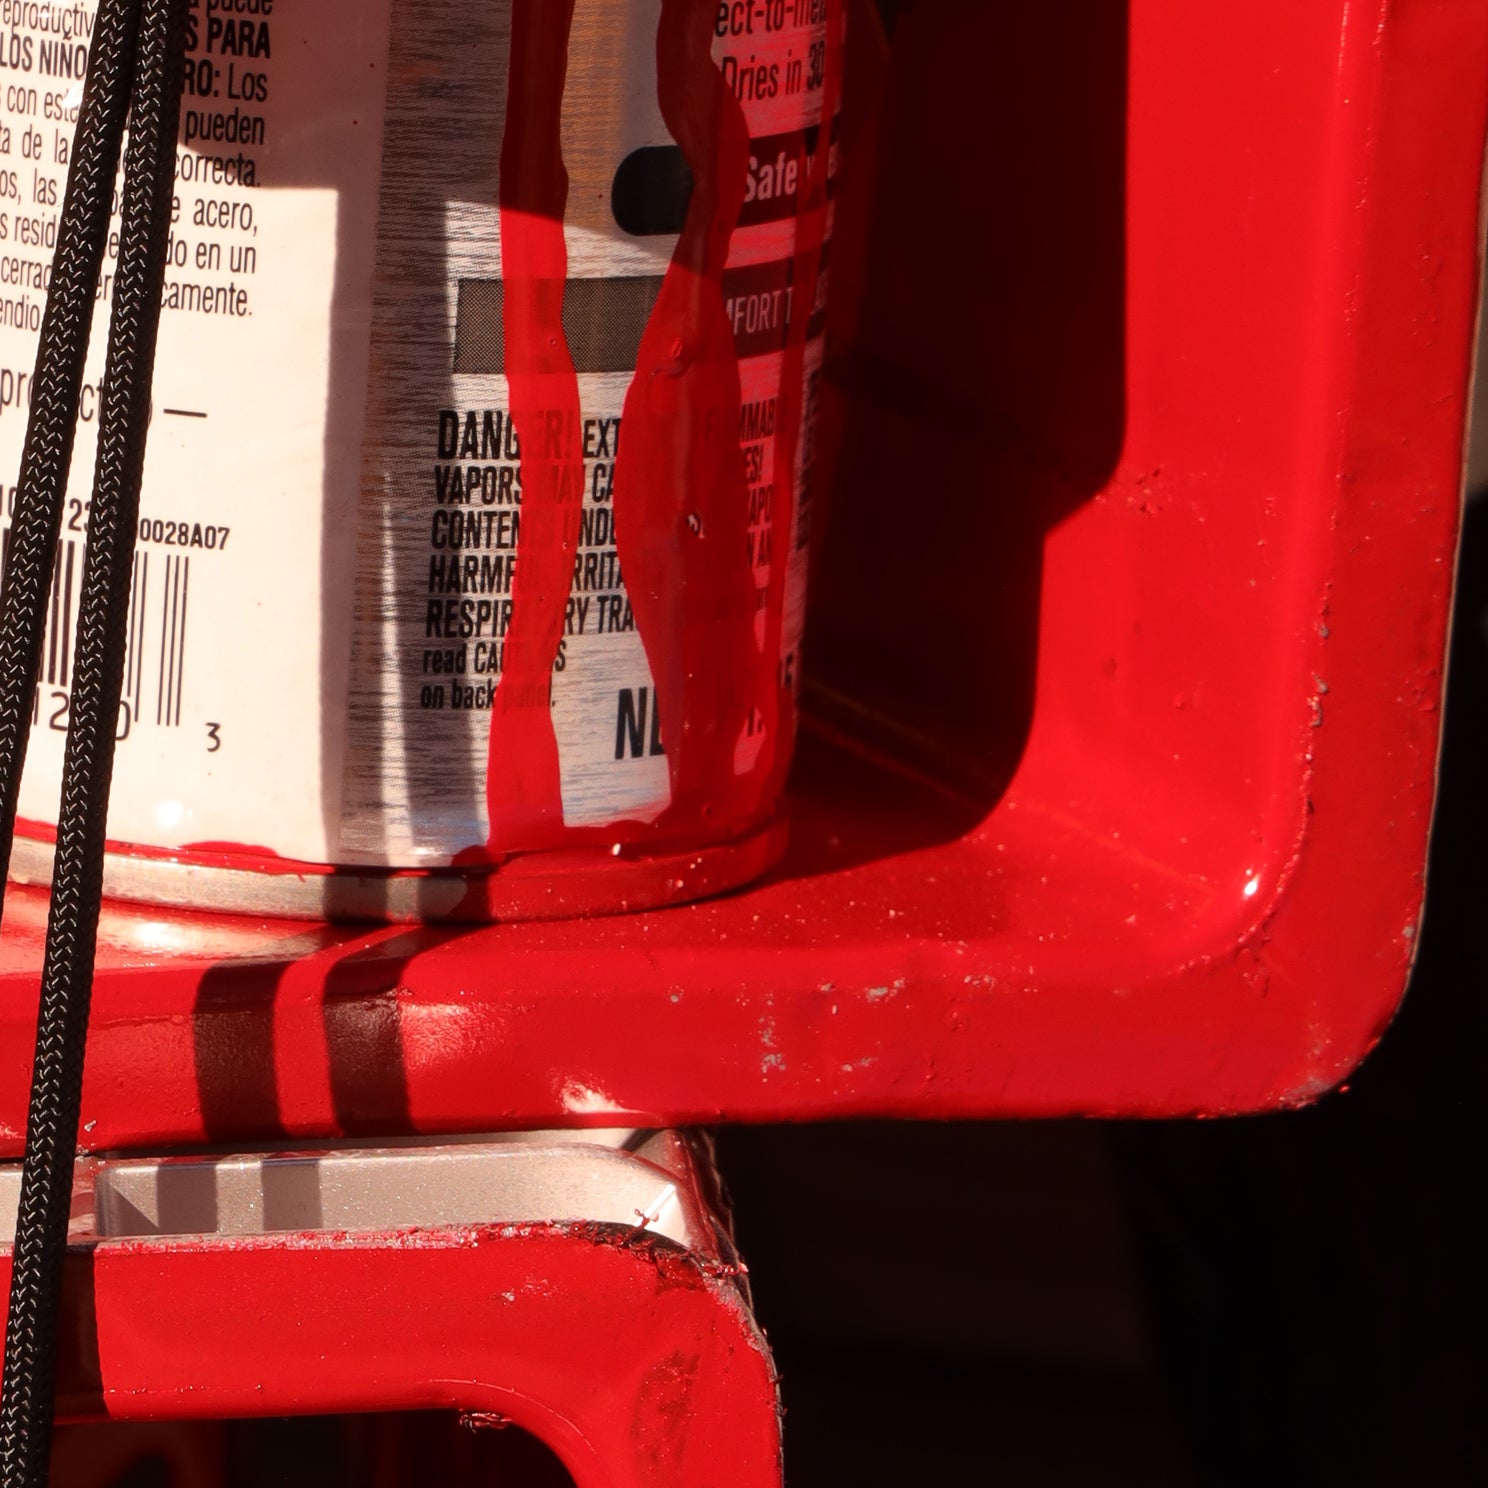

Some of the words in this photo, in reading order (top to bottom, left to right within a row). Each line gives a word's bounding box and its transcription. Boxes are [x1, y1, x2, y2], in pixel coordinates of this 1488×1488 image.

[0, 31, 33, 72] LOS
[39, 34, 88, 81] NIÑO
[206, 17, 271, 59] PARA
[7, 85, 37, 116] con
[228, 62, 268, 102] Los
[786, 49, 802, 95] in
[22, 123, 42, 161] de
[54, 128, 69, 166] la
[185, 107, 265, 146] pueden
[33, 167, 58, 207] las
[193, 198, 257, 237] acero,
[196, 241, 221, 271] en
[230, 245, 257, 275] un
[423, 645, 467, 674] read
[420, 685, 444, 709] on
[451, 678, 495, 710] back
[206, 722, 221, 753] 3
